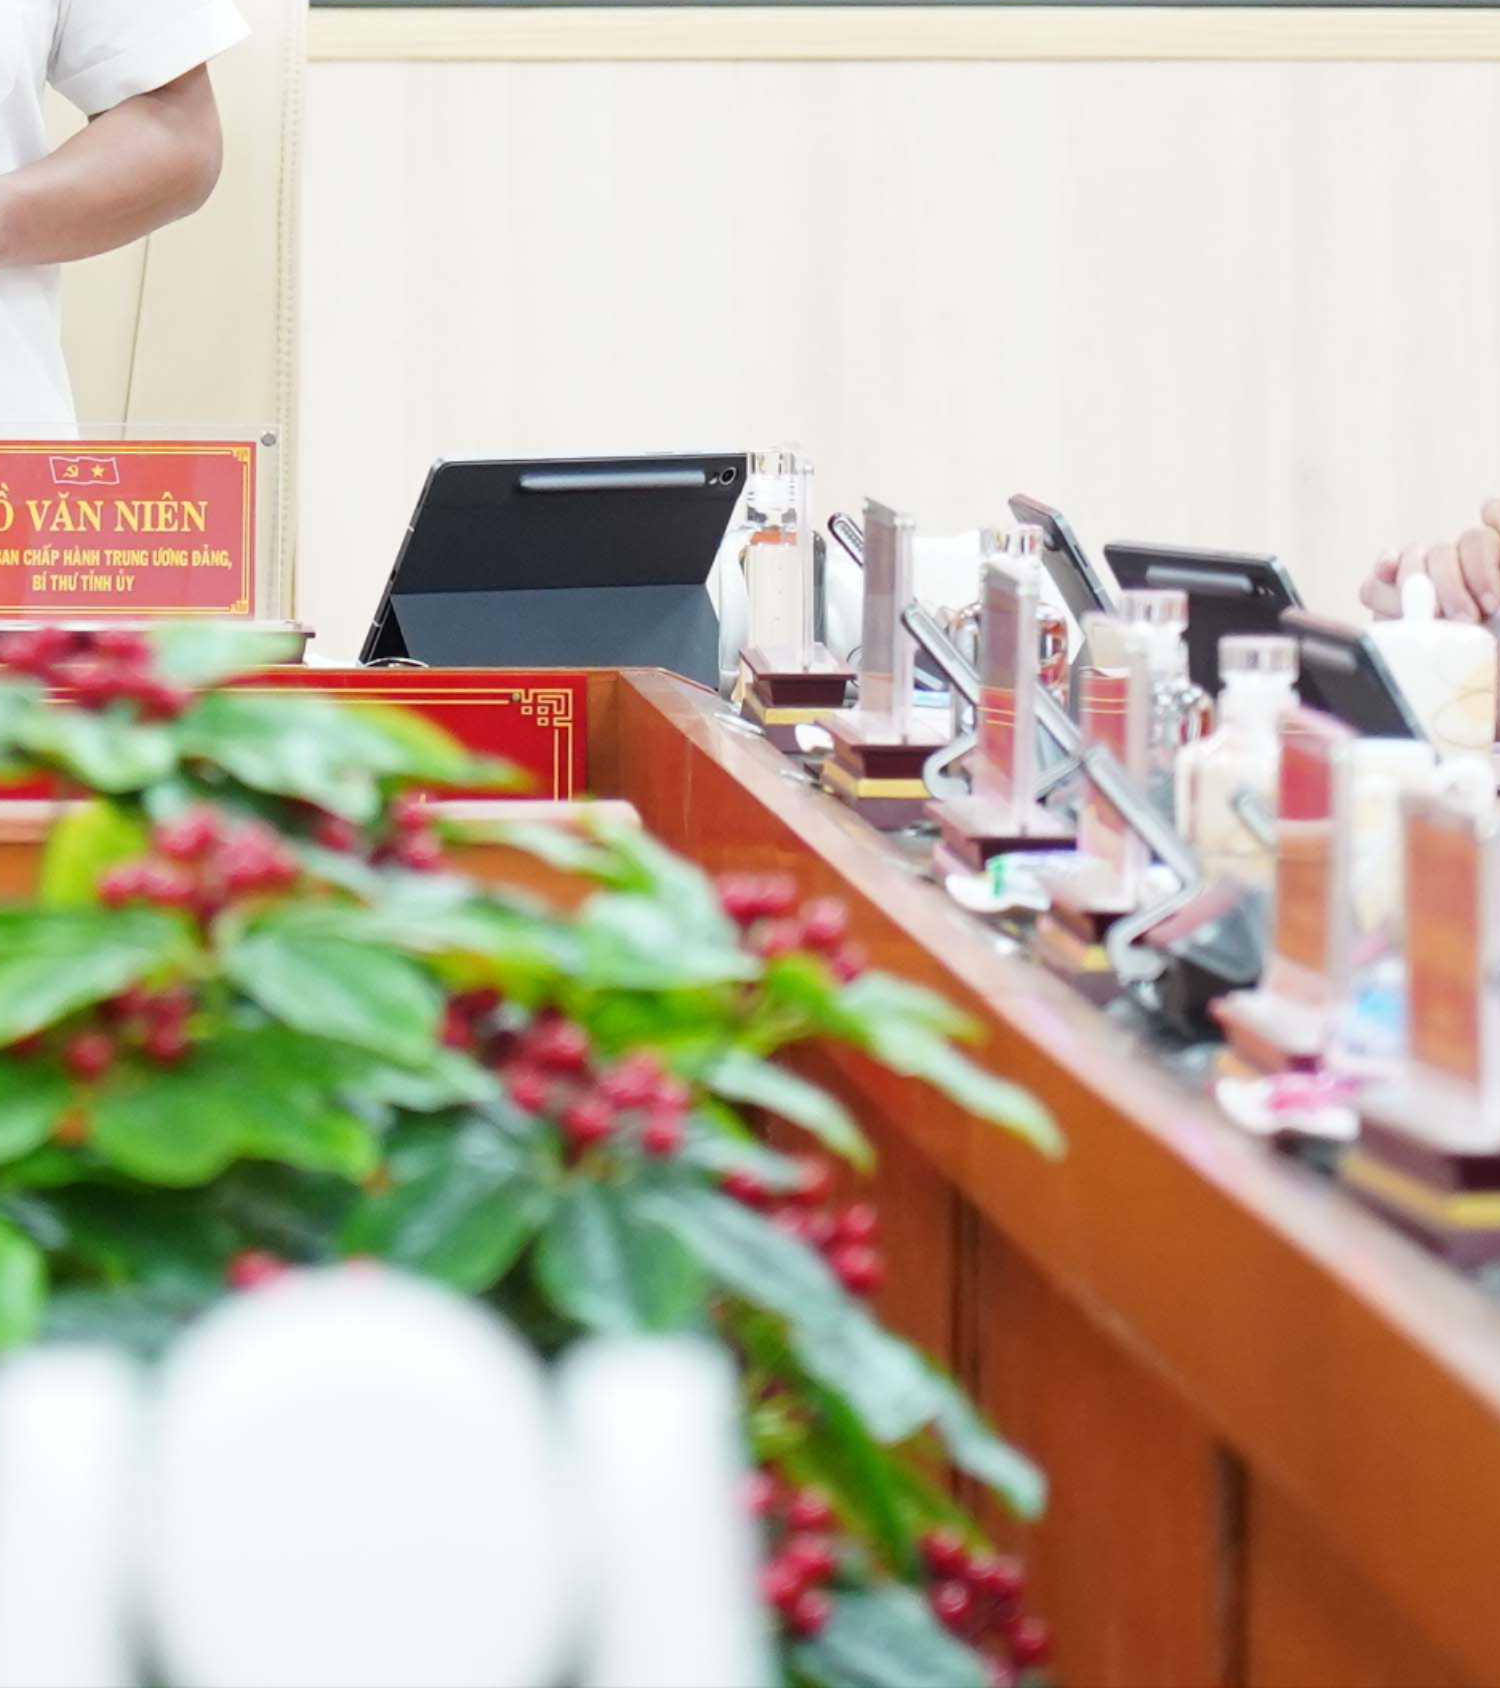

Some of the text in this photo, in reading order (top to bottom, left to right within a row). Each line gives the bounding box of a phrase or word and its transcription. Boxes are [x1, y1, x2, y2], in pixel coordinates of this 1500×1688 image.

[25, 493, 105, 532] VĂN
[114, 492, 208, 532] NIÊN
[23, 544, 60, 566] CHẤP
[63, 547, 100, 566] HÀNH
[105, 550, 149, 566] TRUNG
[153, 548, 188, 567] ƯƠNG
[191, 546, 233, 569] ĐẢNG,
[32, 572, 135, 592] BÍ THƯ TỈNH ỦY
